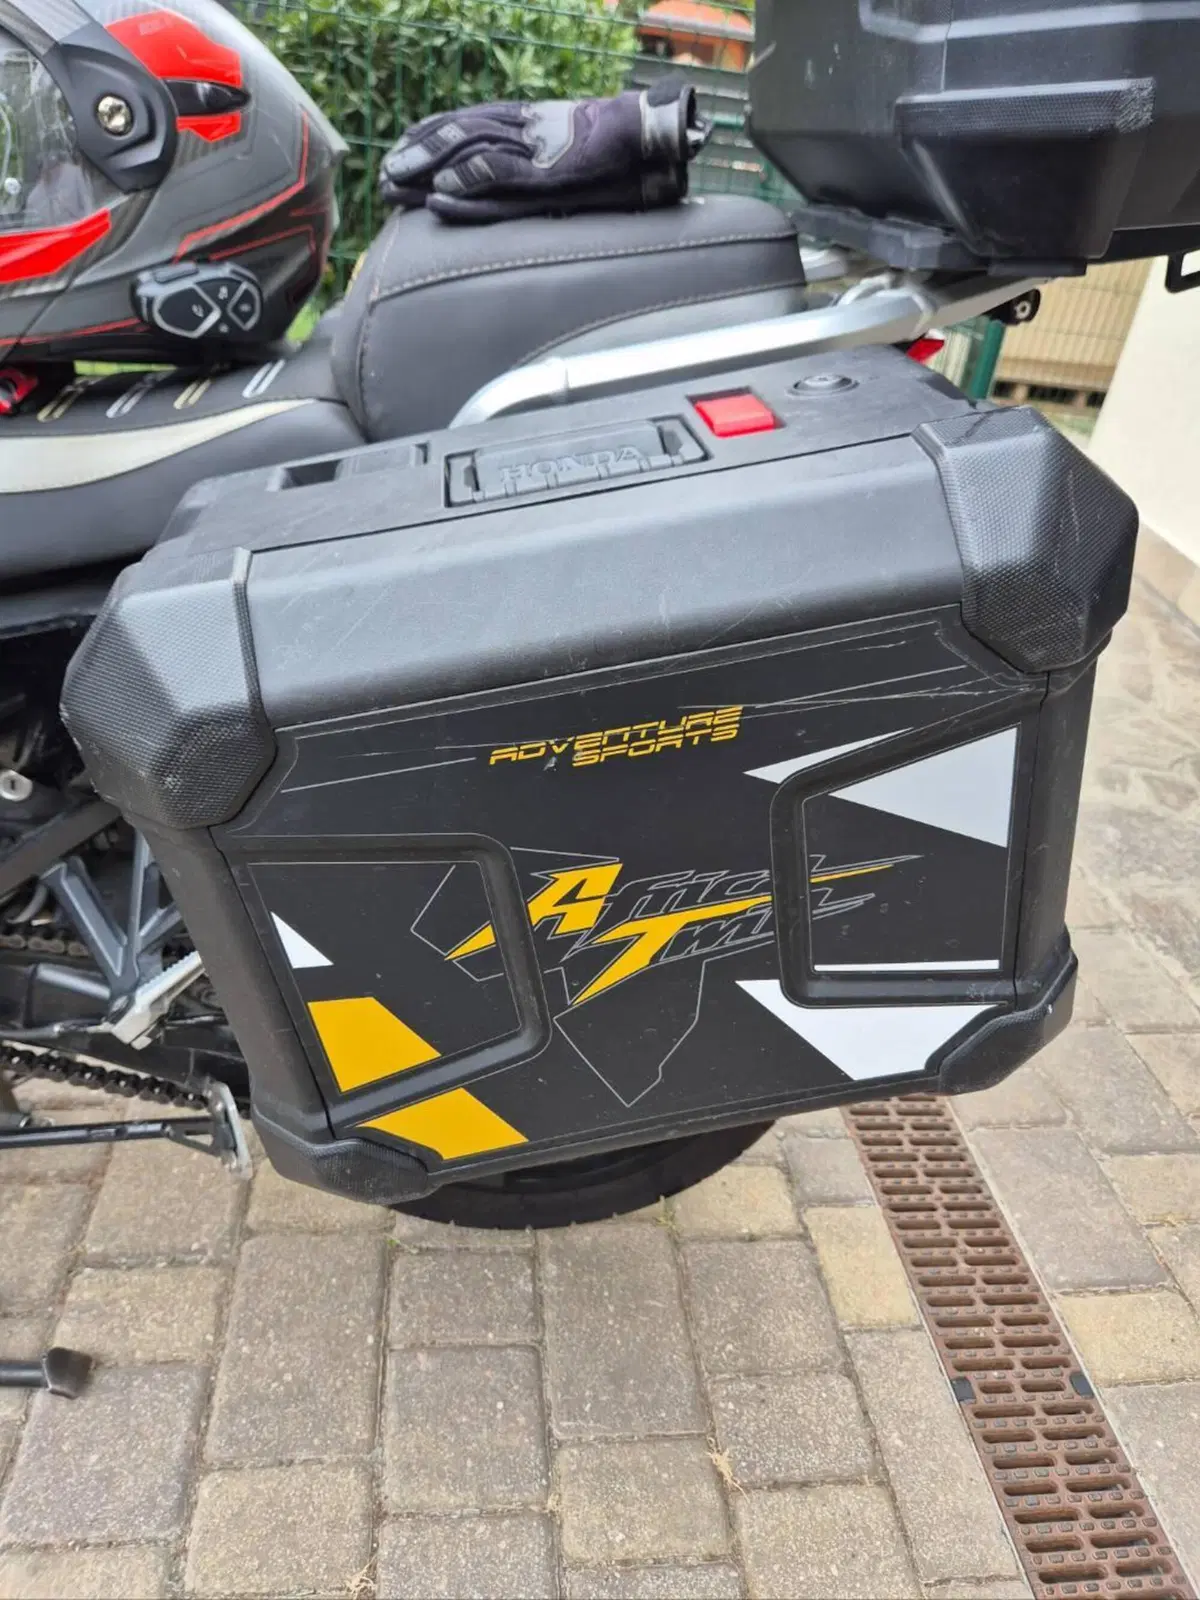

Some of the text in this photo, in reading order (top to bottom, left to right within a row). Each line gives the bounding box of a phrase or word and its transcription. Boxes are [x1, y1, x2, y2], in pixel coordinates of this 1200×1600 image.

[499, 445, 651, 481] HONDA
[489, 705, 743, 765] ADVENTURE
[572, 723, 739, 767] SPORTS
